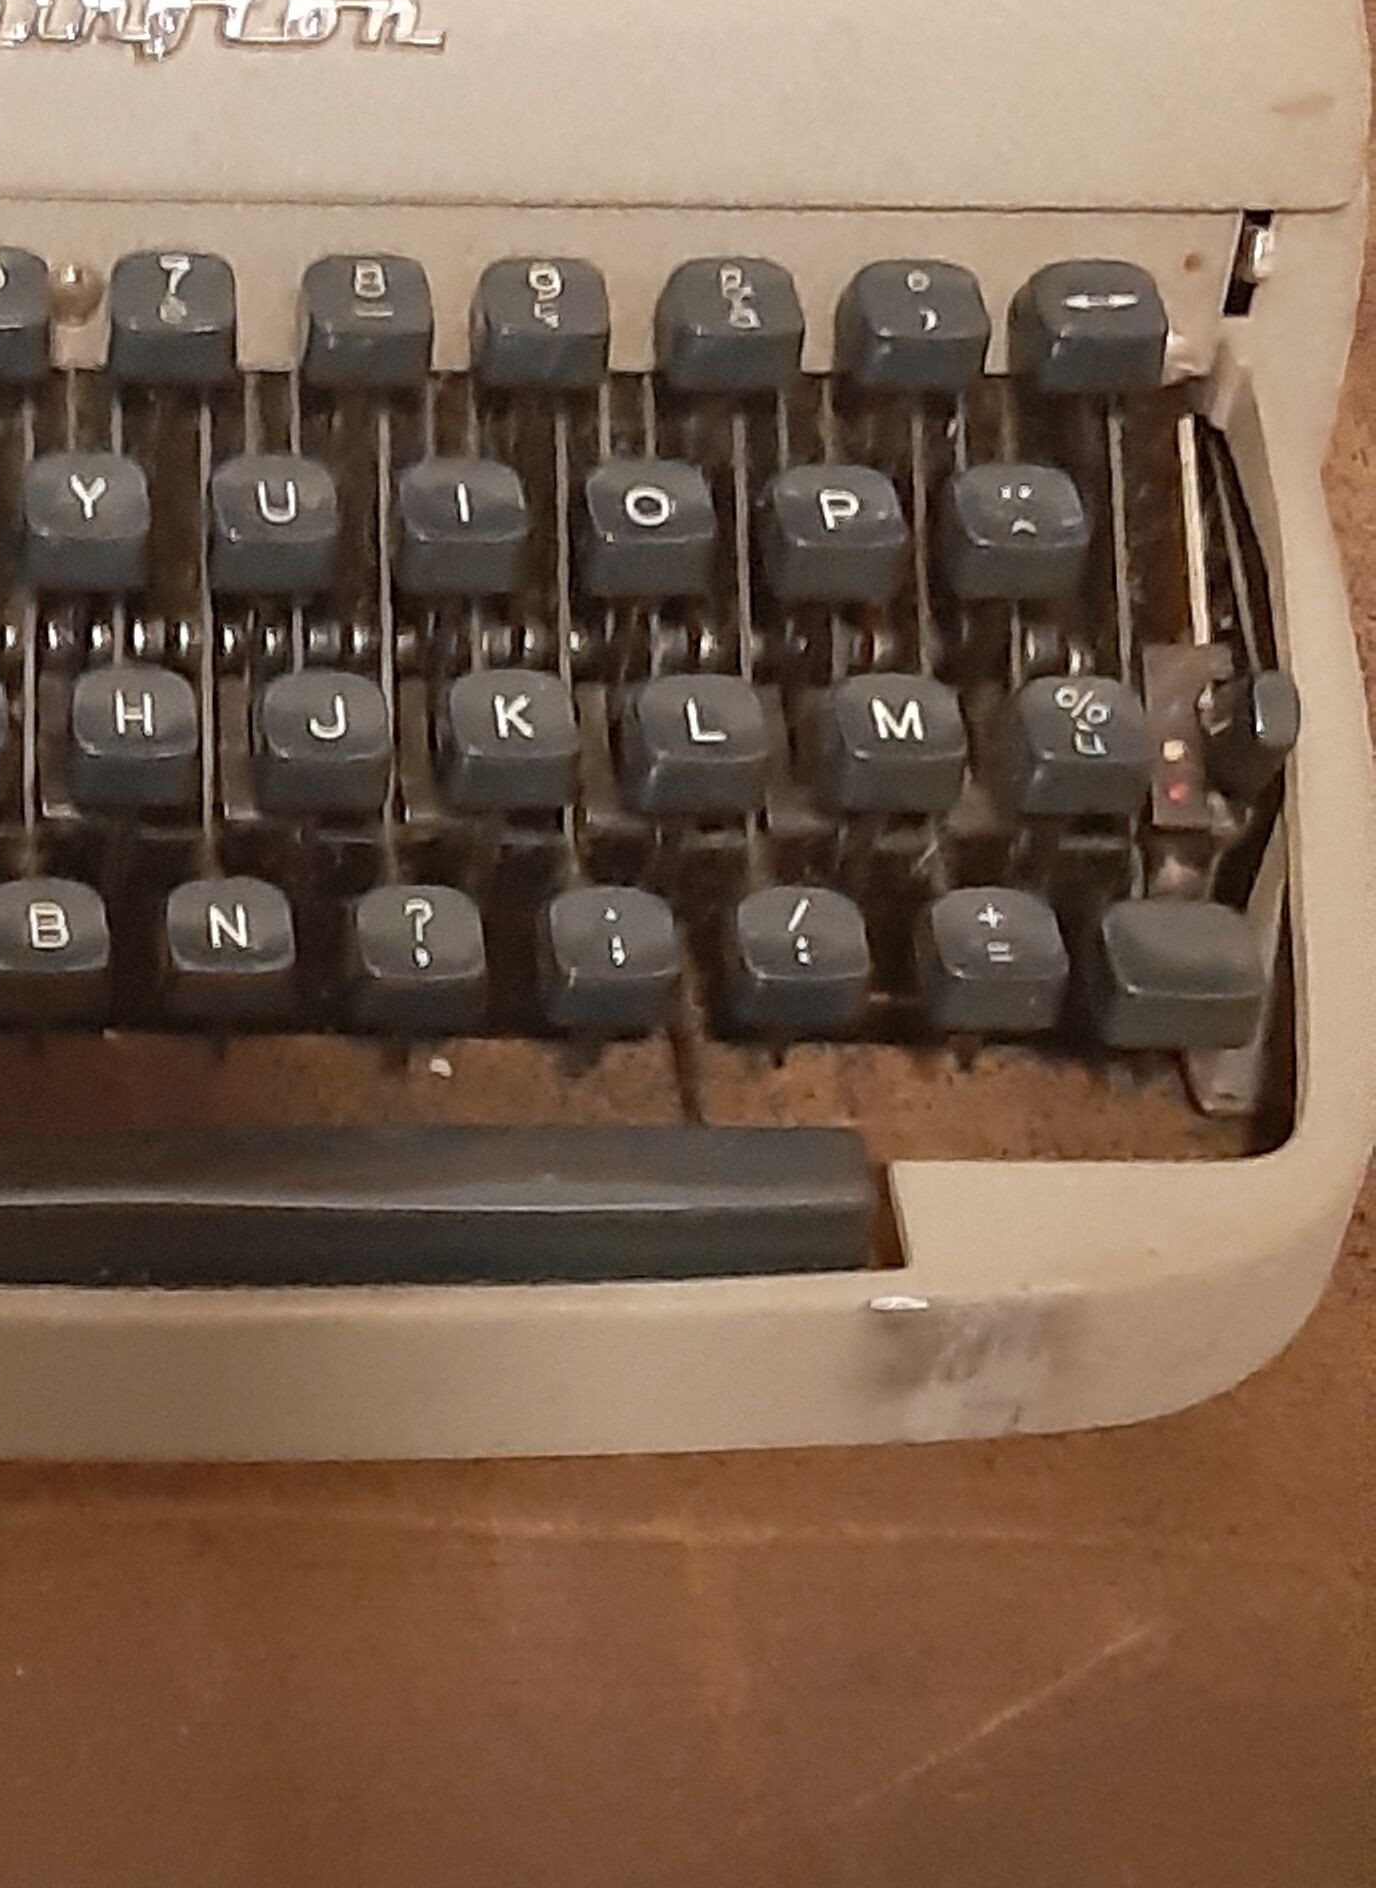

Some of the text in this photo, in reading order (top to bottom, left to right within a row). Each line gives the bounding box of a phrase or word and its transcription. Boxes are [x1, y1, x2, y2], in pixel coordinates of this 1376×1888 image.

[160, 255, 191, 294] 7
[354, 262, 386, 298] 8
[529, 263, 562, 301] 9
[70, 474, 106, 519] Y
[257, 480, 296, 523] U
[625, 486, 672, 526] O
[819, 488, 860, 529] P
[115, 689, 153, 736] H
[310, 695, 346, 739] J
[494, 694, 533, 738] K
[686, 697, 727, 742] L
[871, 698, 924, 740] M
[1054, 685, 1111, 724] %
[29, 902, 70, 948] B
[209, 903, 248, 948] N
